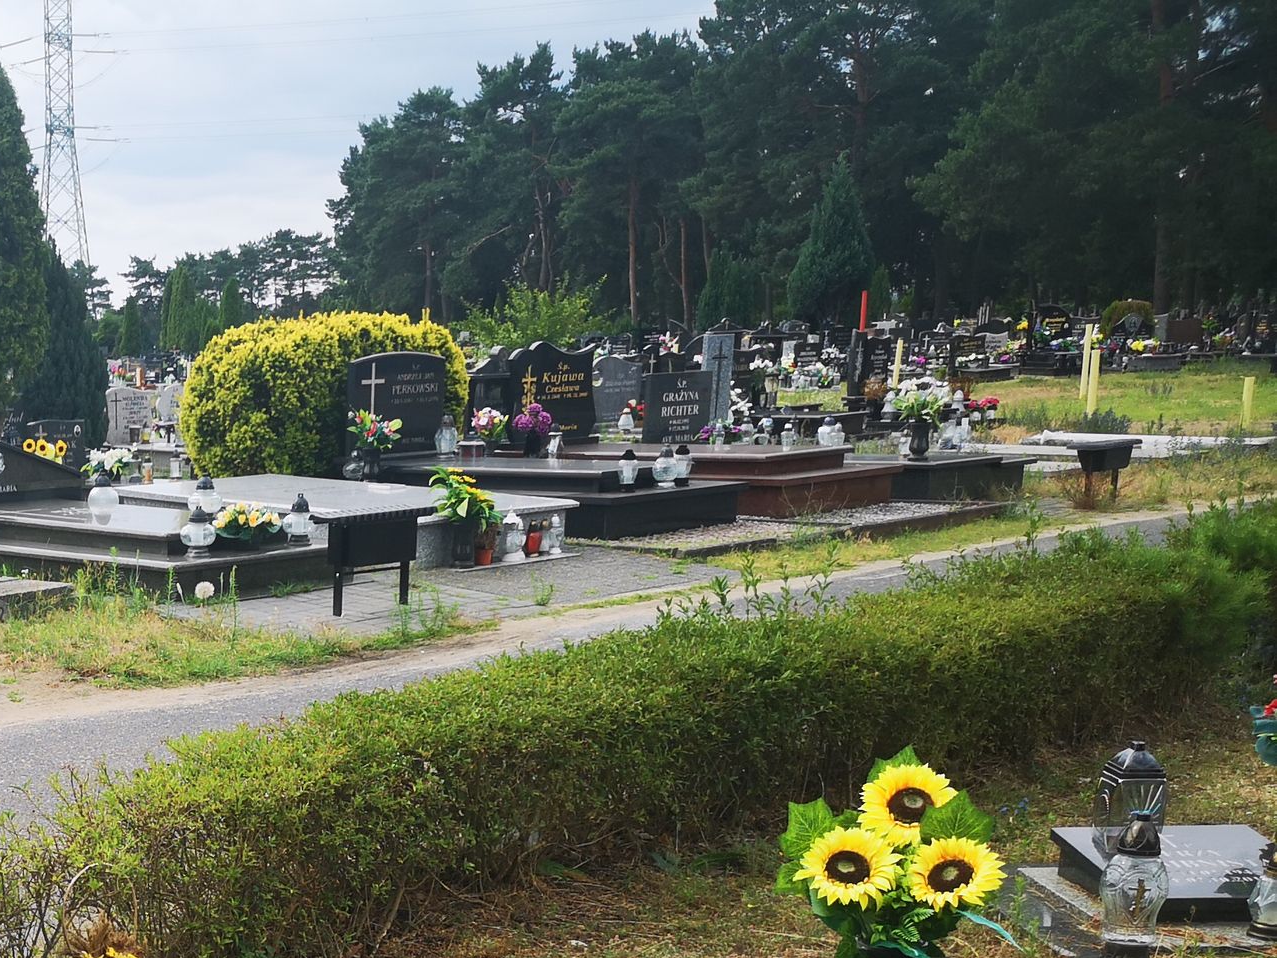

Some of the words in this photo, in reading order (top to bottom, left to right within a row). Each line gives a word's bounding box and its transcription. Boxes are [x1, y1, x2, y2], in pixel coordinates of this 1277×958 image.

[542, 371, 584, 385] Kujawa
[392, 383, 439, 395] PERKOWSKI
[663, 389, 699, 402] GRAŻYNA
[661, 404, 699, 417] RICHTER
